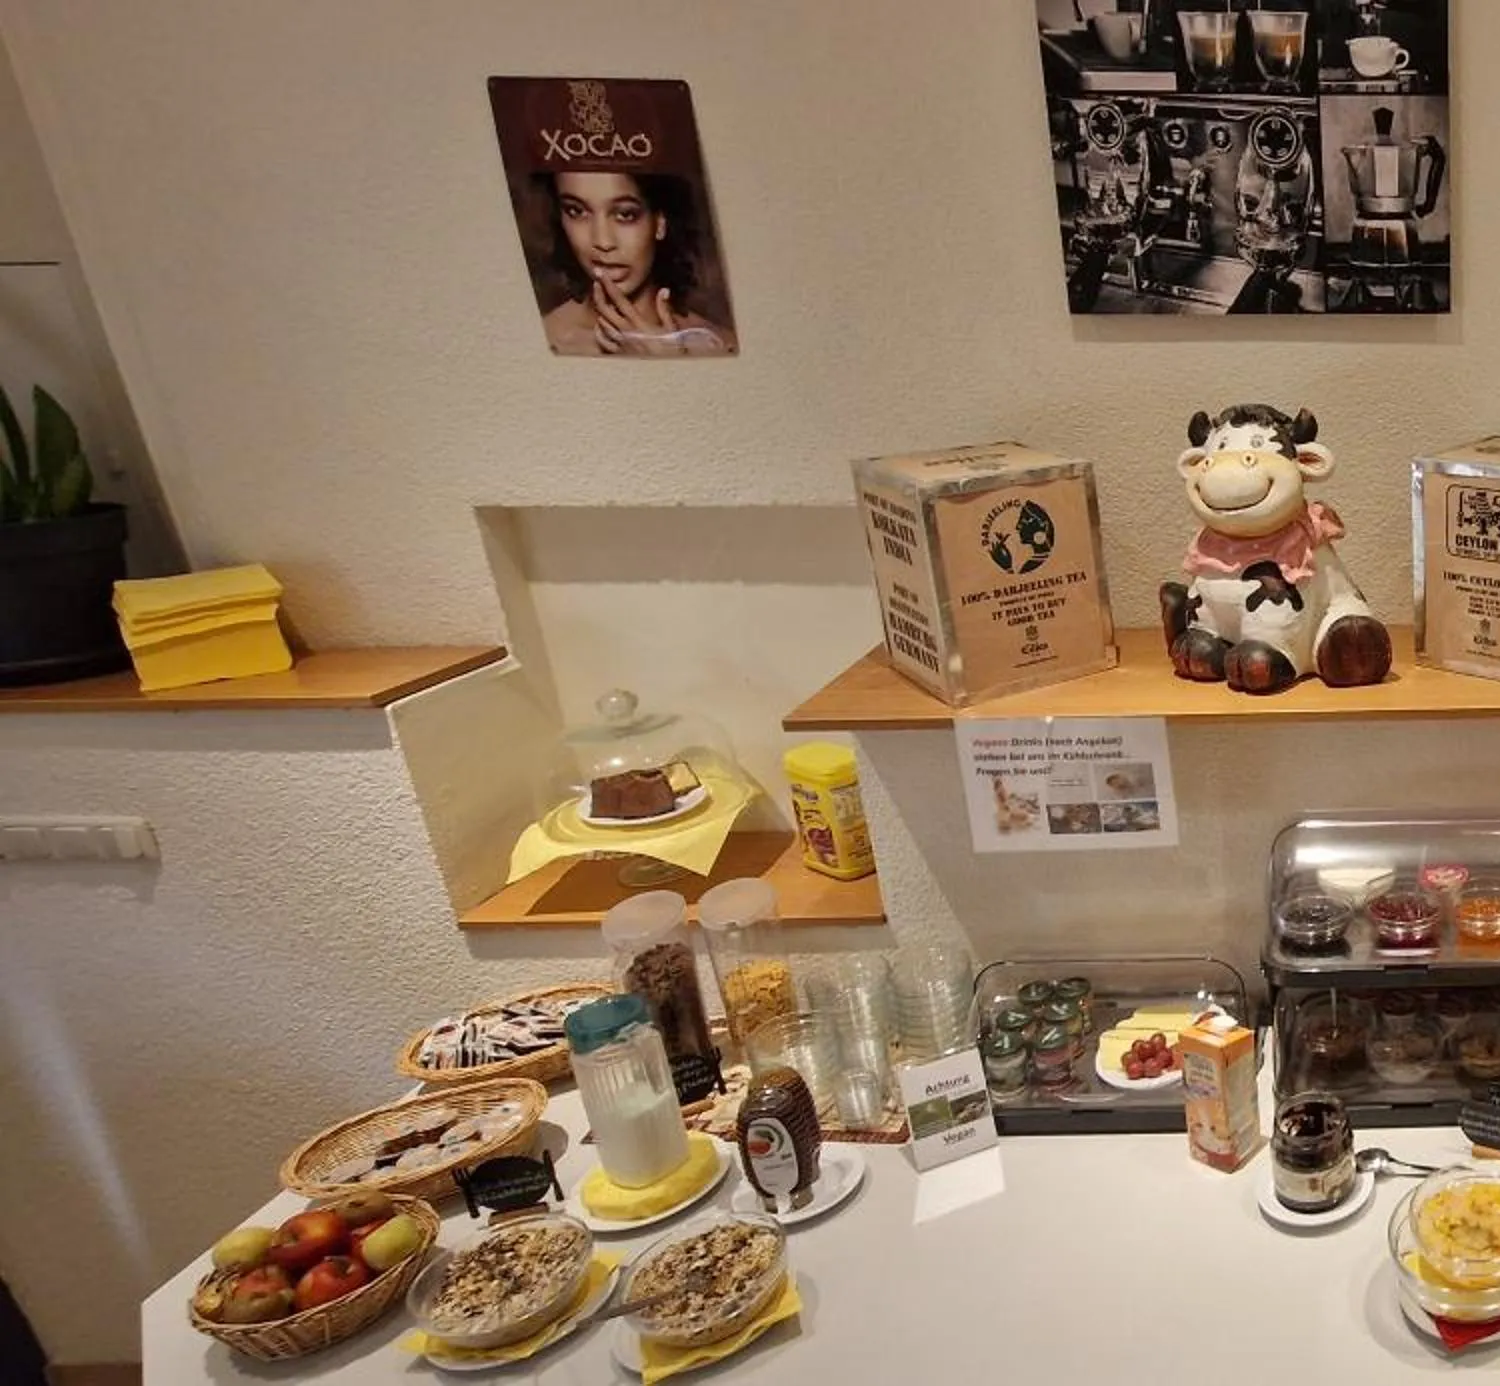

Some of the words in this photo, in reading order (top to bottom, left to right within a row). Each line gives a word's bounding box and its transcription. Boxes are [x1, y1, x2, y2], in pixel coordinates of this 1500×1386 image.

[540, 129, 652, 161] XOCAO
[1456, 533, 1498, 551] CEYLON
[961, 591, 991, 606] 100%
[993, 575, 1063, 599] DARJEELING
[1065, 570, 1087, 584] TEA
[1037, 609, 1055, 621] TEA
[926, 1075, 970, 1095] Achtung
[943, 1127, 976, 1144] Vegan
